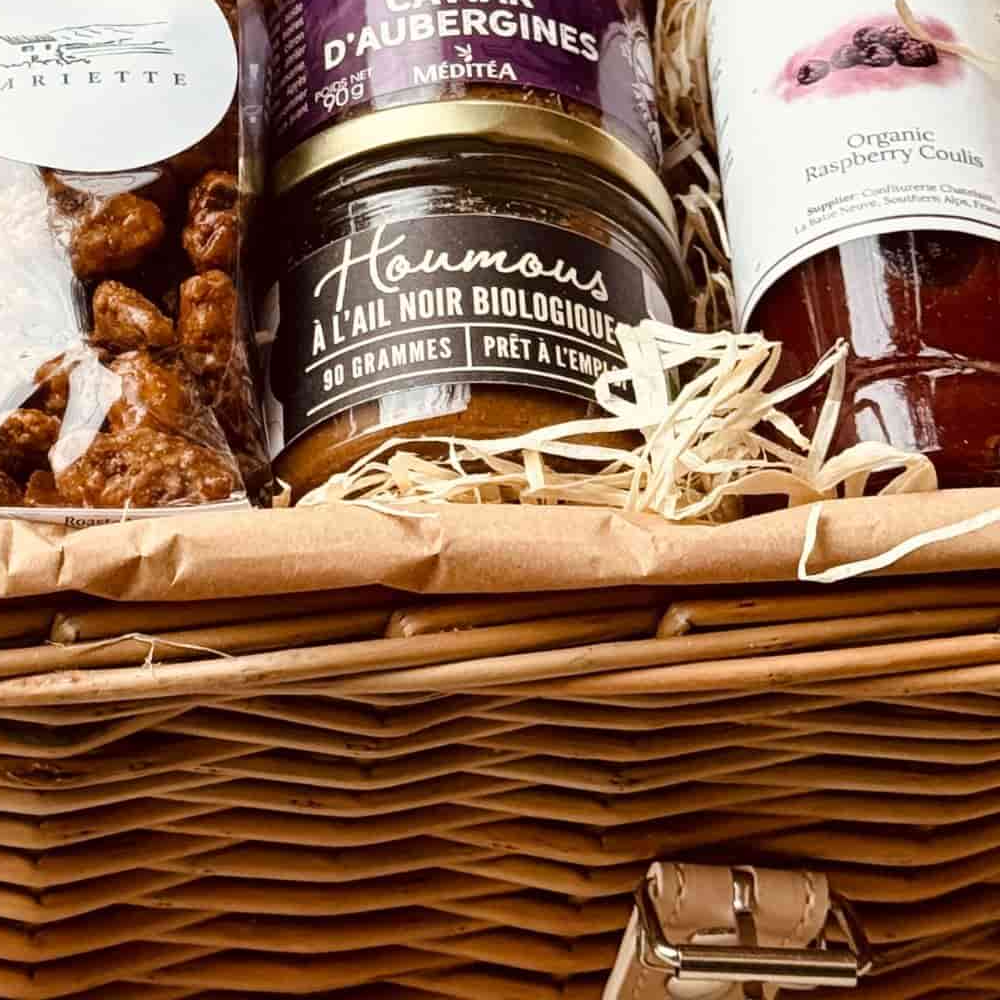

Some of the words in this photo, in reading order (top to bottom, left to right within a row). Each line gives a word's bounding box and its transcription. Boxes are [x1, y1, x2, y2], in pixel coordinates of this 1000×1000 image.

[322, 7, 600, 73] D'AUBERGINES
[804, 149, 913, 182] Raspberry
[918, 144, 985, 169] Coulis
[846, 126, 937, 148] Organic
[313, 223, 610, 312] Houmous
[312, 318, 327, 356] À
[332, 303, 390, 345] L'AIL
[399, 287, 463, 324] NOIR
[472, 286, 617, 344] BIOLOGIQUE
[483, 333, 532, 362] PRÊT
[538, 334, 551, 362] À
[323, 368, 344, 392] 90
[351, 337, 452, 380] GRAMMES
